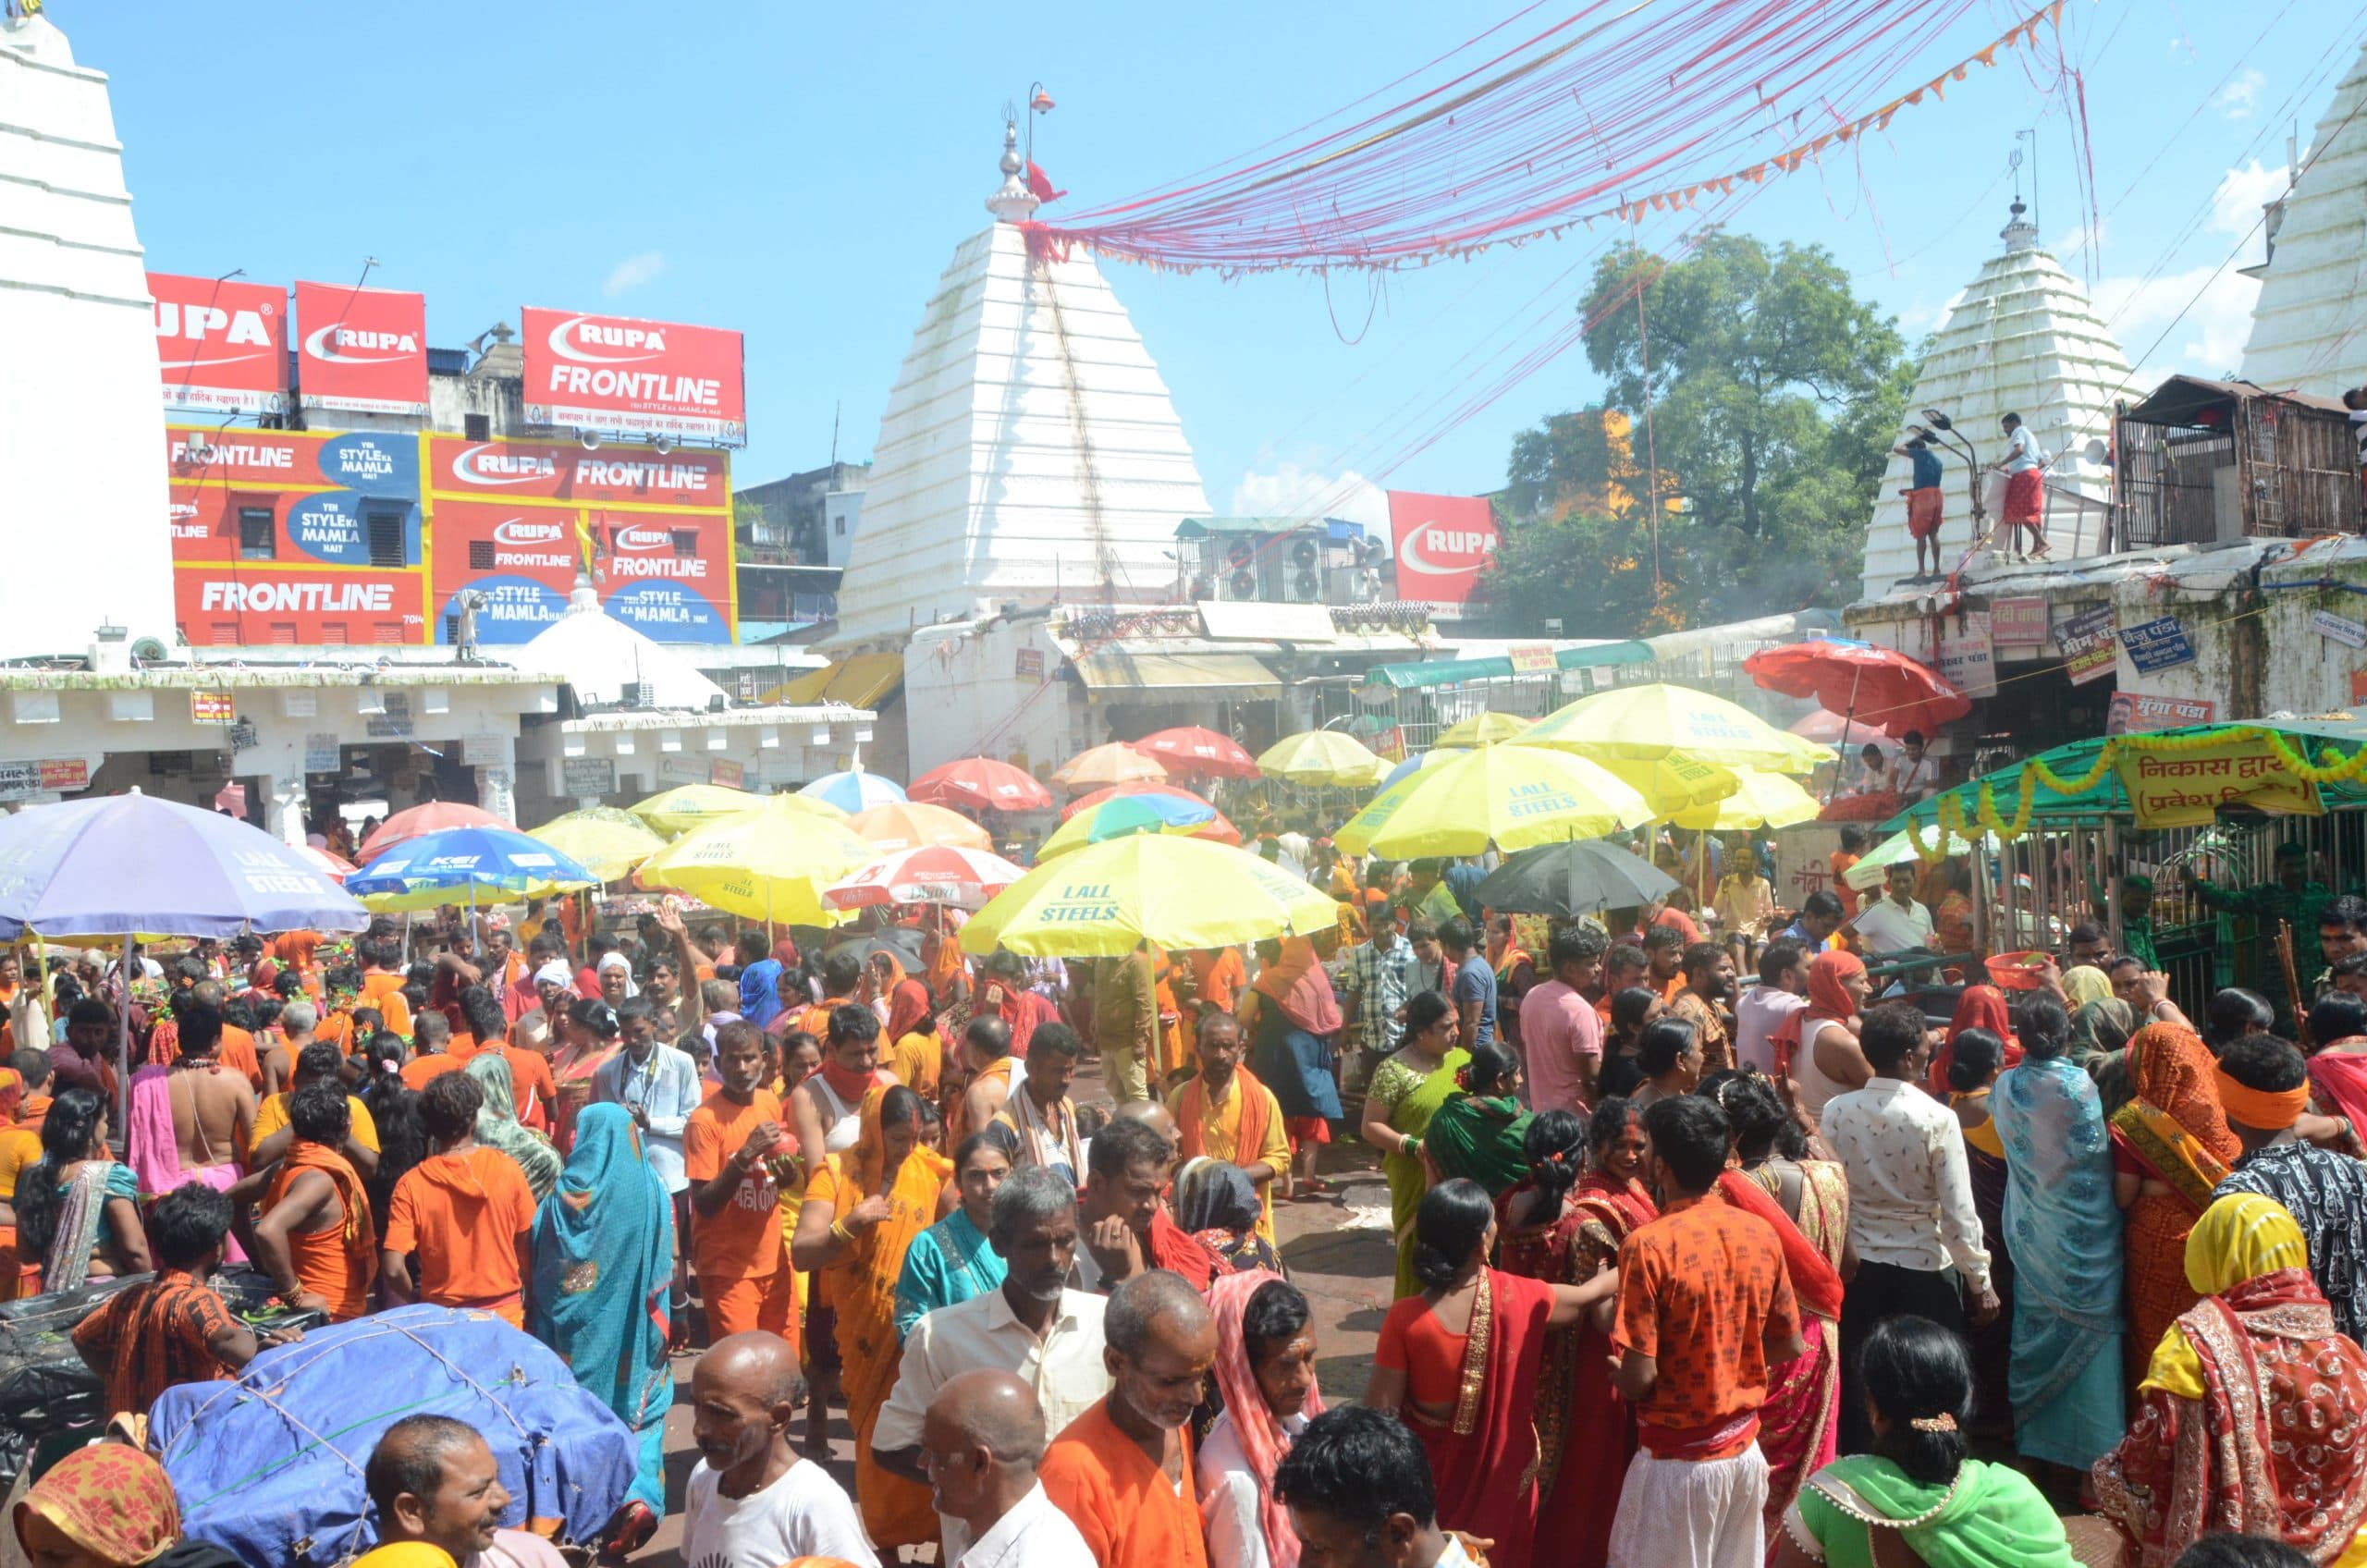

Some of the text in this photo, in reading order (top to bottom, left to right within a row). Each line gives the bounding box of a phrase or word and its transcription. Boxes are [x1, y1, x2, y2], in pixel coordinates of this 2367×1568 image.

[155, 301, 272, 347] UPA
[336, 328, 418, 352] RUPA
[579, 324, 666, 350] RUPA
[549, 364, 720, 406] FRONTLINE
[339, 448, 382, 461] STYLE
[341, 460, 393, 474] MAMLA
[478, 455, 556, 474] RUPA
[576, 460, 707, 490] FRONTLINE
[323, 503, 338, 512] YEH
[301, 513, 346, 528] STYLE
[301, 528, 360, 544] MAMLA
[509, 524, 563, 539] RUPA
[1427, 529, 1498, 554] RUPA
[495, 553, 571, 568] FRONTLINE
[612, 557, 707, 577] FRONTLINE
[202, 582, 395, 612] FRONTLINE
[496, 586, 540, 603] STYLE
[640, 591, 681, 606] STYLE
[492, 604, 548, 621] MAMLA
[635, 606, 690, 622] MAMLA
[2138, 755, 2232, 778] निकास
[1509, 782, 1552, 798] LALL
[1509, 796, 1577, 817] STEELS
[429, 855, 482, 866] KEI
[245, 875, 325, 894] STEELS
[1063, 884, 1110, 899] LALL
[1039, 906, 1120, 922] STEELS
